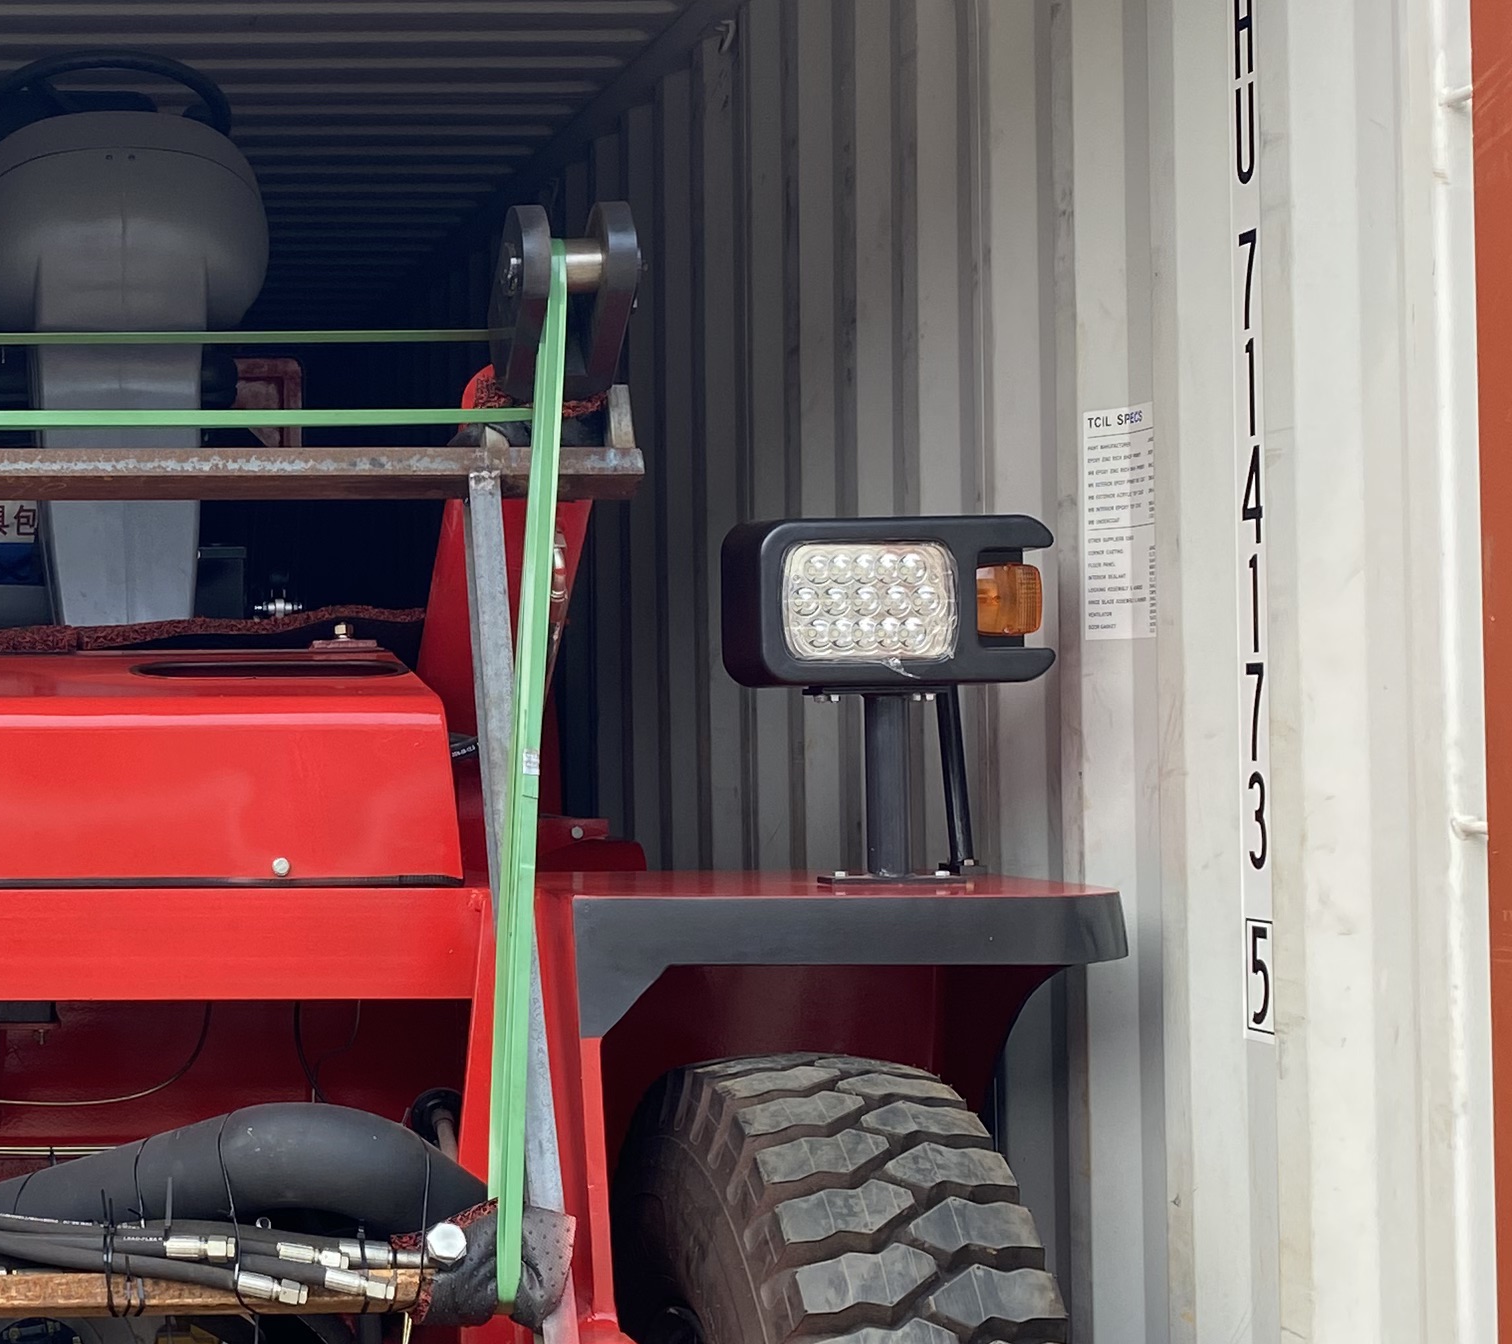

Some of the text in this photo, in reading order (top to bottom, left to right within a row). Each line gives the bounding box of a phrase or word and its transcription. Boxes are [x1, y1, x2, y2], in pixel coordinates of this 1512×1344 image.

[1088, 410, 1143, 428] TCIL SPECS
[1238, 228, 1266, 870] 714173
[1251, 925, 1269, 1025] 5
